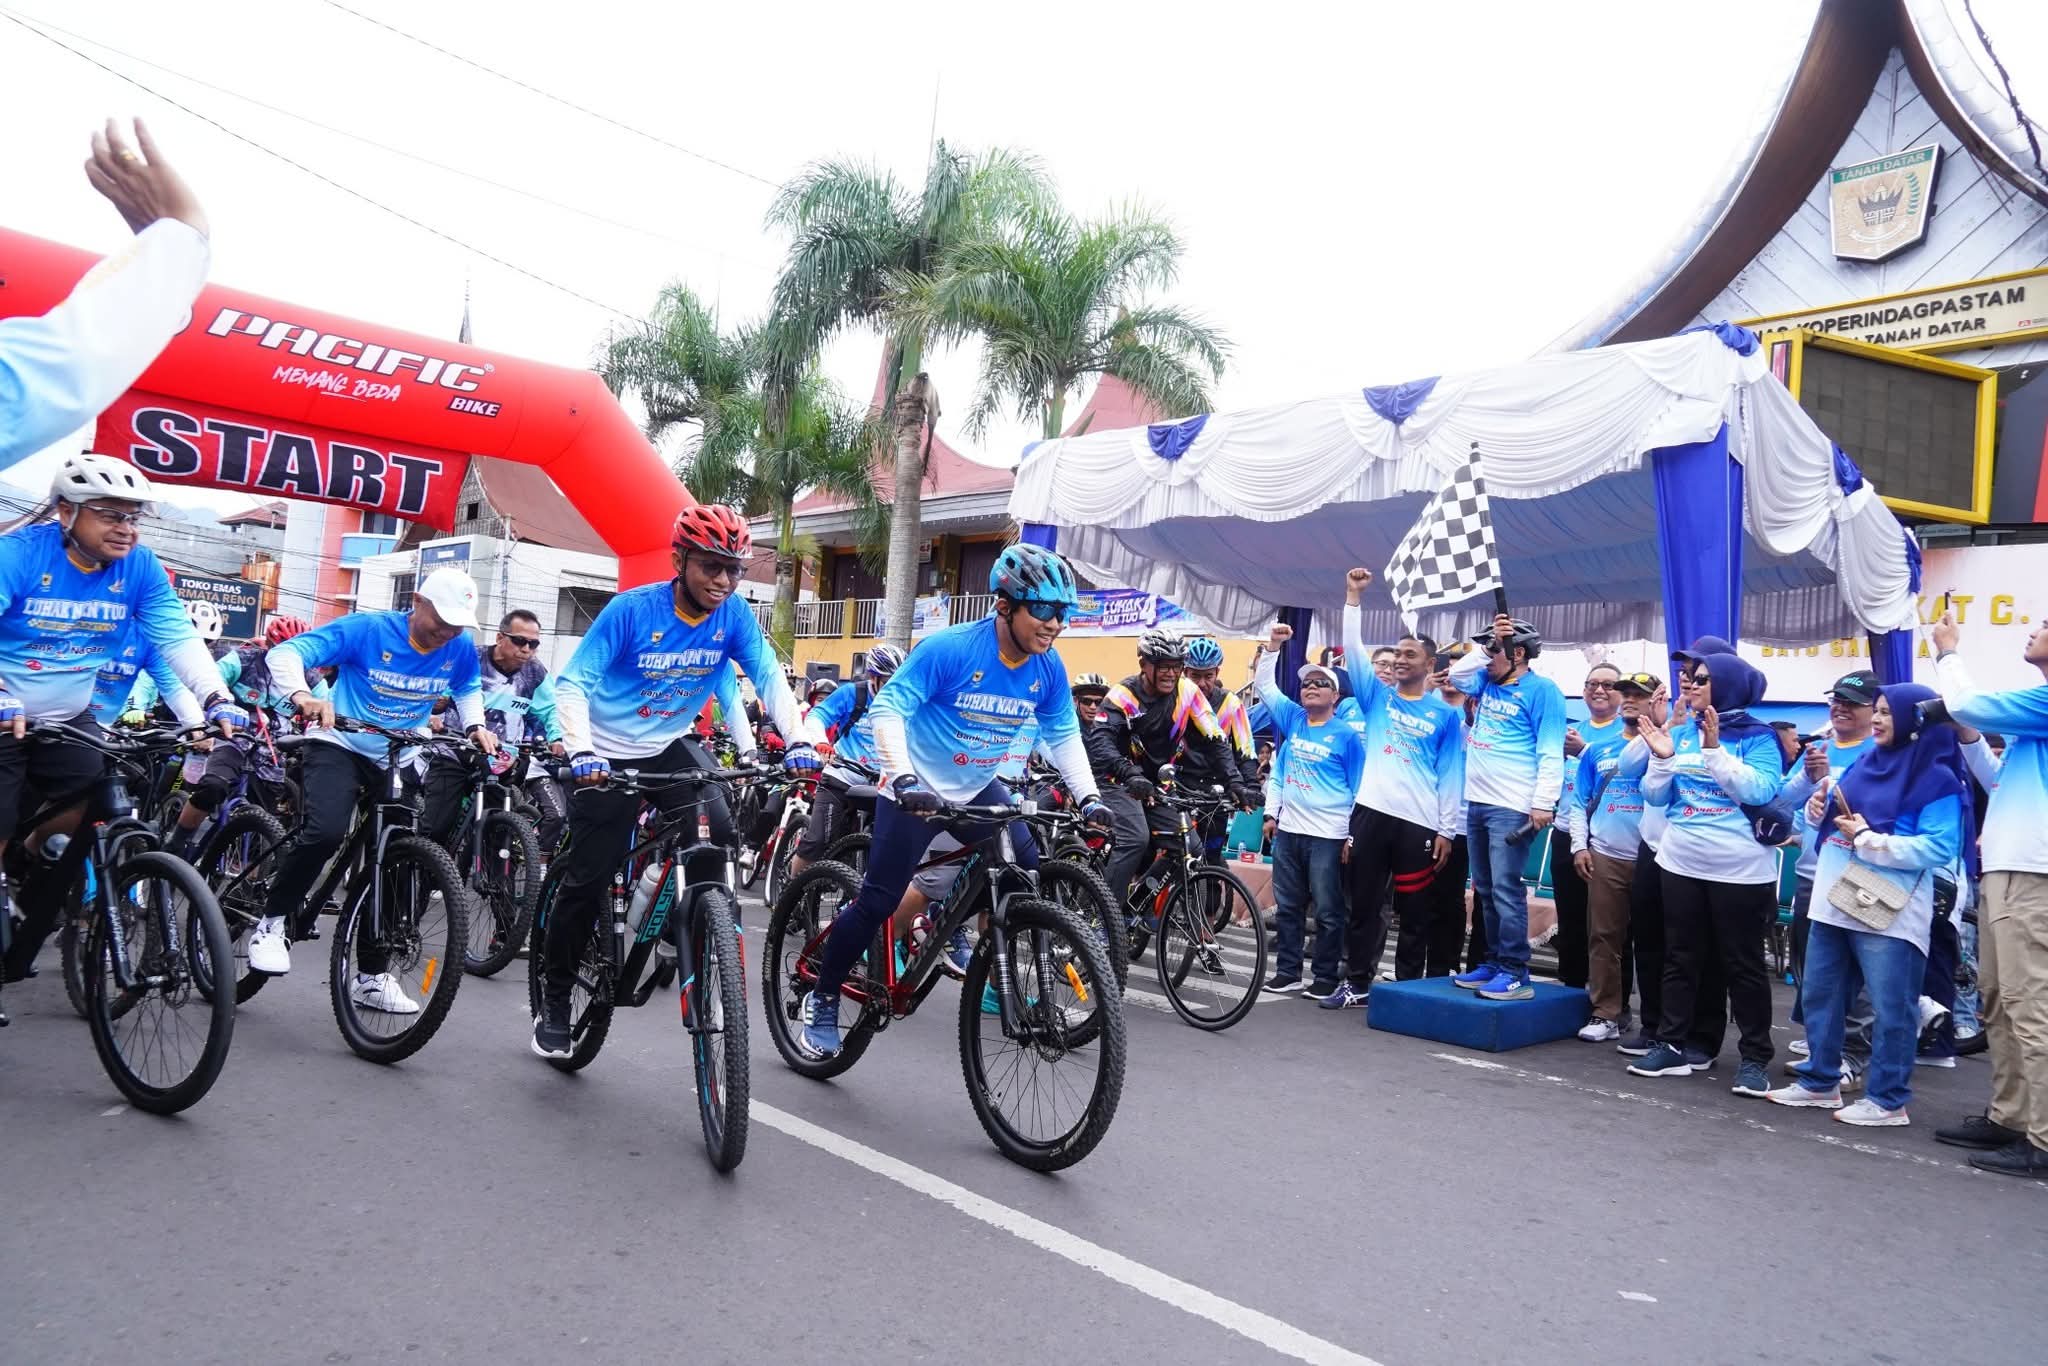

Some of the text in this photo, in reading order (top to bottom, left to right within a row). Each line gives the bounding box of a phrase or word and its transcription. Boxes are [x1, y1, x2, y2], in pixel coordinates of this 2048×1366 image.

[1840, 151, 1926, 181] TANAH DATAR
[1928, 317, 1987, 338] DATAR
[206, 306, 486, 393] PACIFIC
[271, 365, 402, 402] MEMANG BEDA
[450, 397, 500, 417] BIKE
[130, 406, 443, 514] START
[181, 578, 242, 595] TOKO EMAS
[176, 588, 257, 606] RMATA RENO
[1103, 597, 1145, 616] LUHAK
[1102, 612, 1120, 626] NAN
